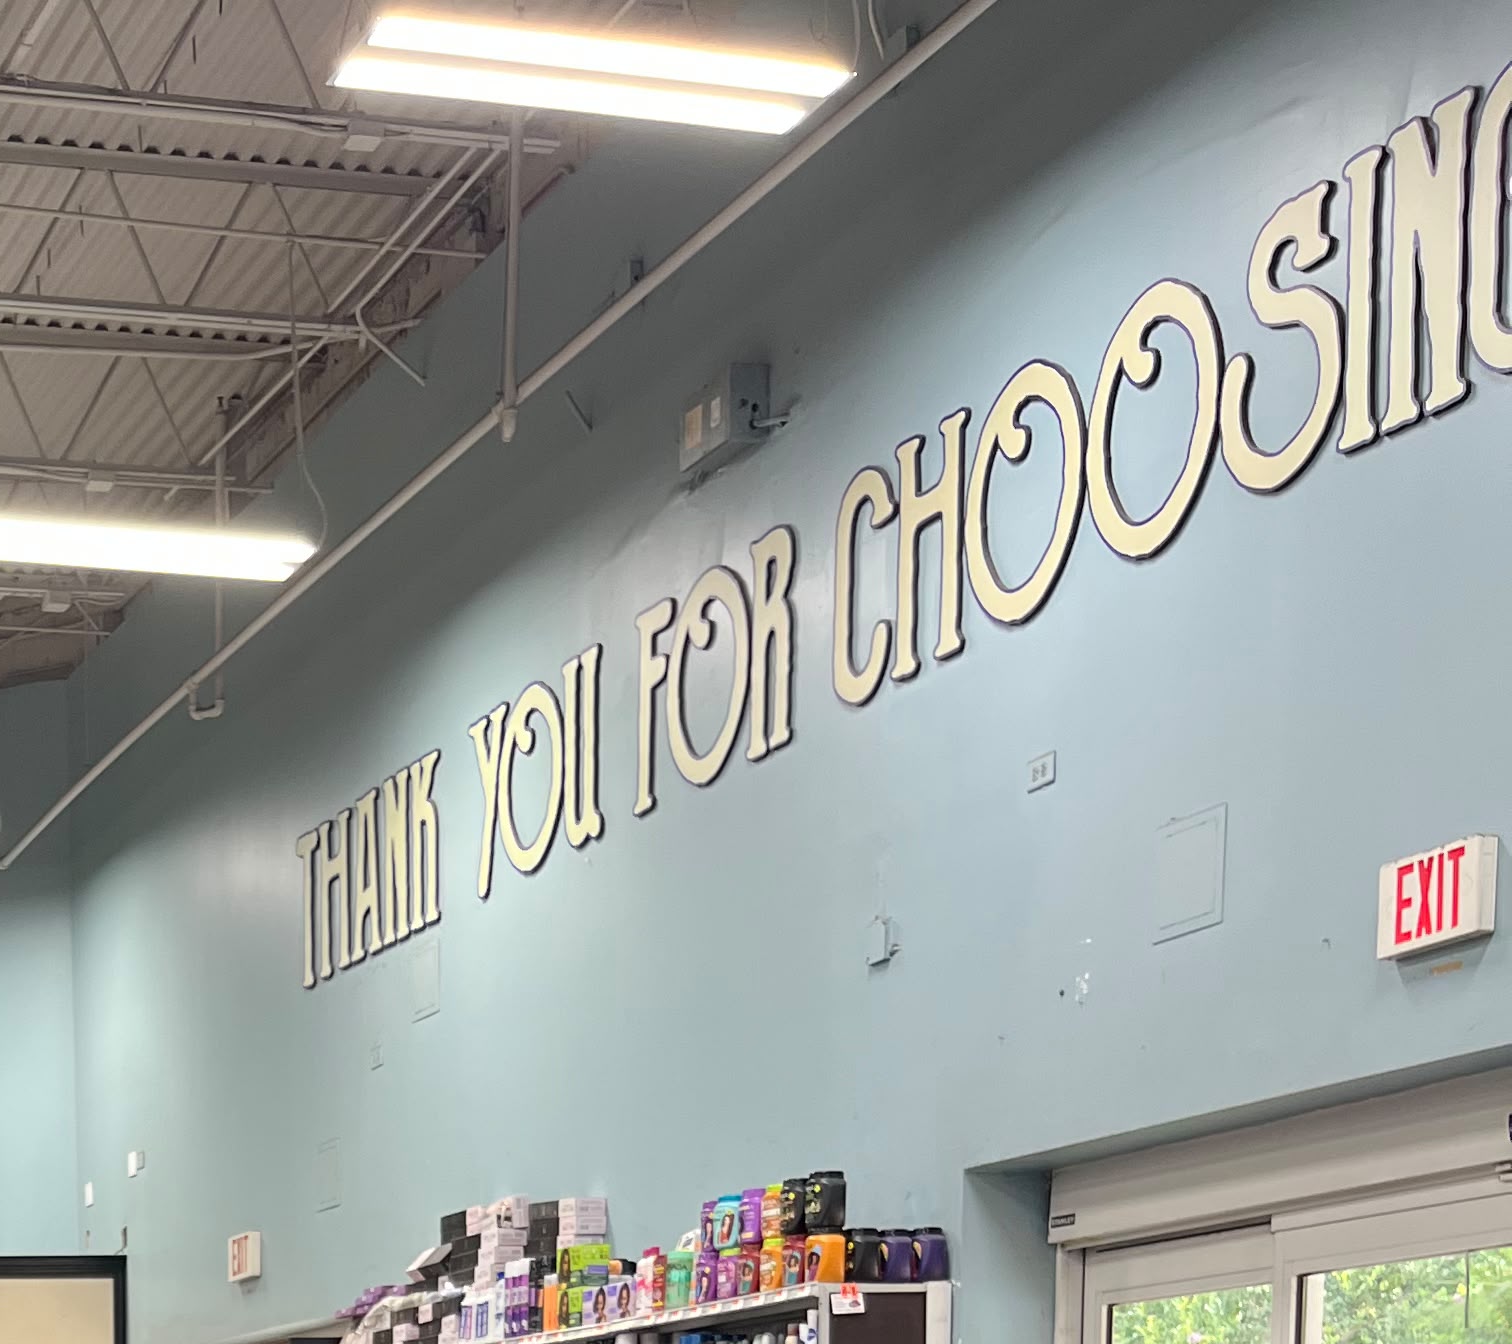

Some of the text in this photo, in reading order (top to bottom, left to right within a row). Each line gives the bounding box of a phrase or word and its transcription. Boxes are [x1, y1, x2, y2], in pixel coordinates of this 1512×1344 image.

[295, 748, 443, 990] THANK
[468, 643, 606, 901] YOU
[631, 523, 798, 818] FOR
[1395, 845, 1466, 945] EXIT
